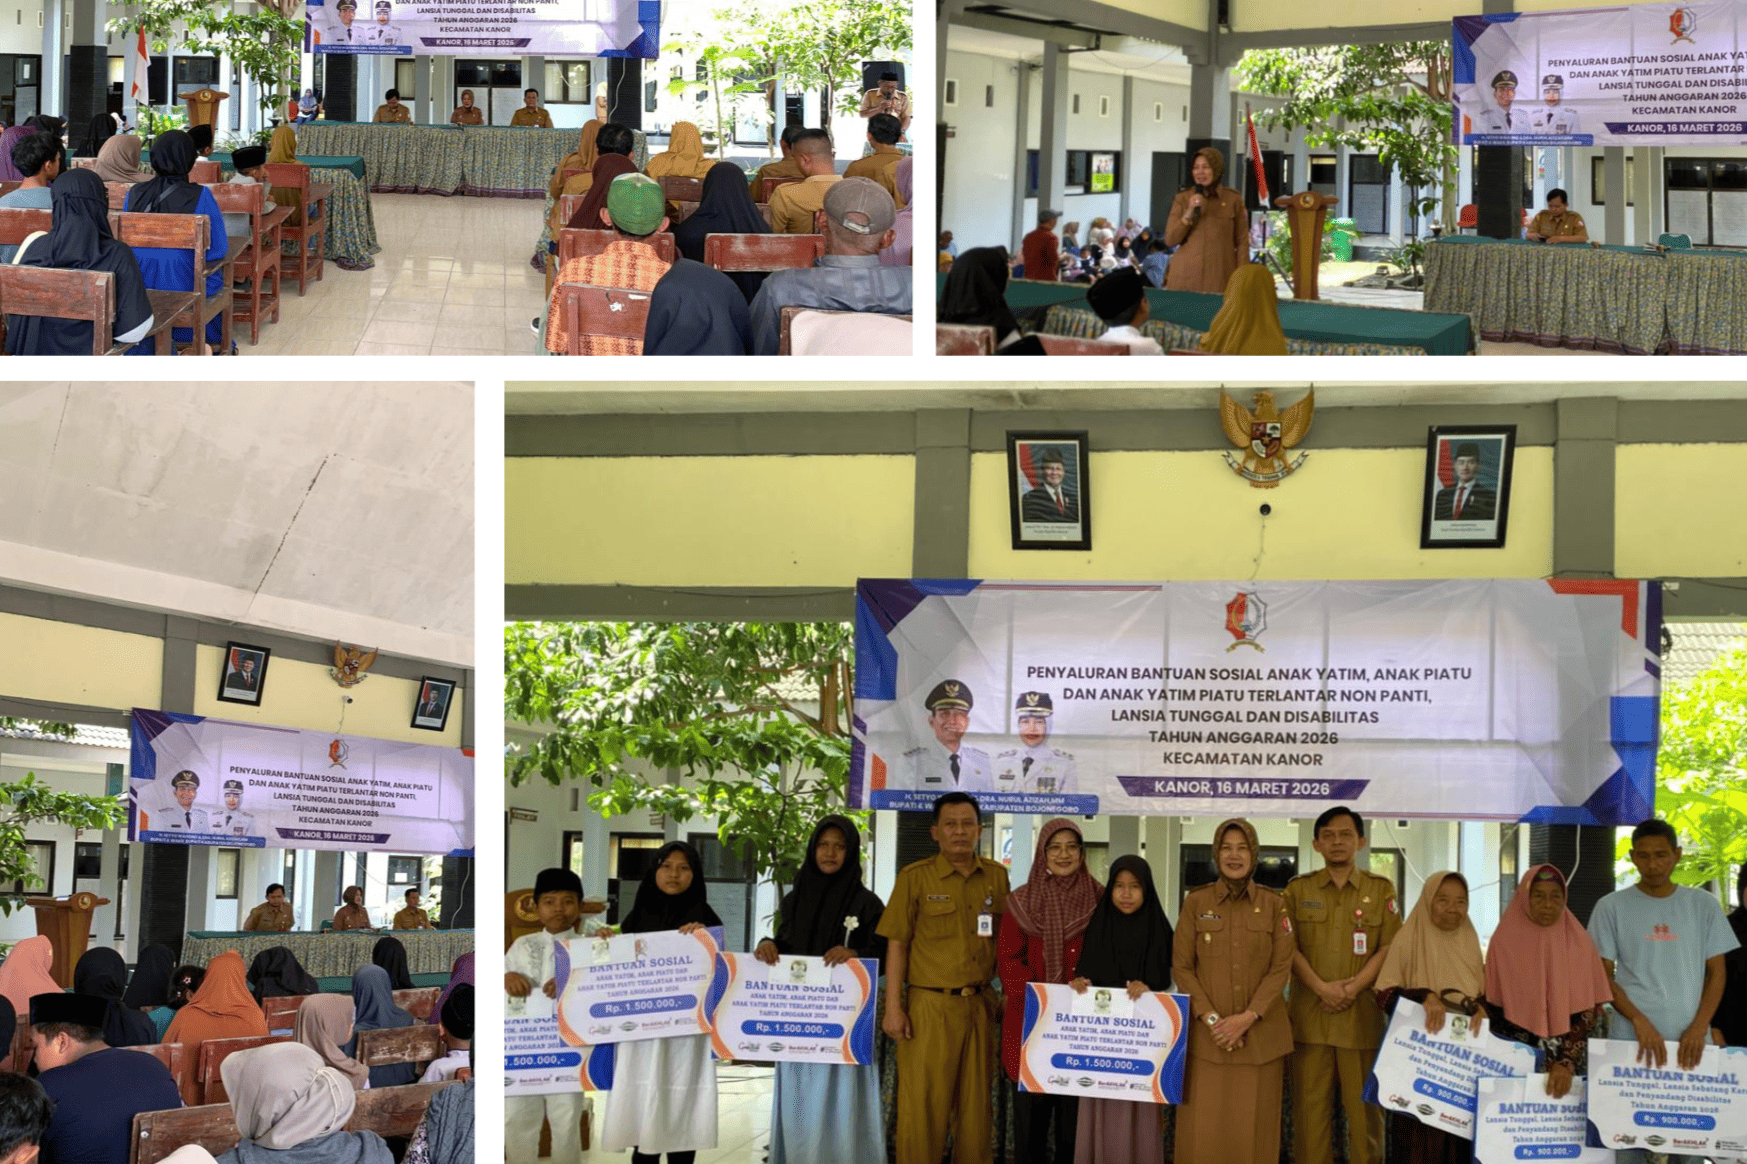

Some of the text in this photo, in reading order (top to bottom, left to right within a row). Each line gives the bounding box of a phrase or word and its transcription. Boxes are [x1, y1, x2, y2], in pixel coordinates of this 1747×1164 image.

[1548, 58, 1609, 67] PENYALURAN
[1610, 56, 1658, 65] BANTUAN
[1660, 54, 1694, 63] SOSIAL
[1697, 52, 1727, 61] ANAK
[1570, 65, 1744, 78] DAN ANAK YATIM PIATU TERLANTAR
[1599, 82, 1633, 90] LANSIA
[1635, 80, 1683, 89] TUNGGAL
[1685, 79, 1707, 88] DAN
[1622, 91, 1746, 102] TAHUN ANGGARAN 2026
[1632, 105, 1737, 115] KECAMATAN KANOR
[1627, 123, 1742, 133] KANOR, 16 MARET 2026
[1027, 666, 1471, 683] PENYALURAN BANTUAN SOSIAL ANAK YATIM, ANAK PIATU
[1063, 688, 1432, 704] DAN ANAK YATIM PIATU TERLANTAR NON PANTI,
[1111, 710, 1379, 723] LANSIA TUNGGAL DAN DISABILITAS
[1149, 731, 1338, 744] TAHUN ANGGARAN 2026
[1163, 752, 1323, 766] KECAMATAN KANOR
[230, 766, 433, 791] PENYALURAN BANTUAN SOSIAL ANAK YATIM, ANAK PIATU
[249, 779, 417, 801] DAN ANAK YATIM PIATU TERLANTAR NON PANTI,
[1154, 781, 1330, 795] KANOR, 16 MARET 2026
[273, 792, 396, 808] LANSIA TUNGGAL DAN DISABILITAS
[292, 805, 379, 818] TAHUN ANGGARAN 2026
[298, 816, 372, 827] KECAMATAN KANOR
[293, 831, 323, 840] KANOR,
[332, 832, 358, 841] MARET
[359, 834, 375, 842] 2026
[650, 955, 693, 968] SOSIAL
[605, 999, 682, 1014] Rp. 1.500.000,-
[1055, 1013, 1155, 1029] BANTUAN SOSIAL
[756, 1022, 830, 1035] Rp. 1.500.000,-
[1065, 1056, 1139, 1072] Rp. 1.500.000,-
[1473, 1054, 1515, 1076] SOSIAL
[1613, 1066, 1684, 1081] BANTUAN
[1499, 1103, 1557, 1114] BANTUAN
